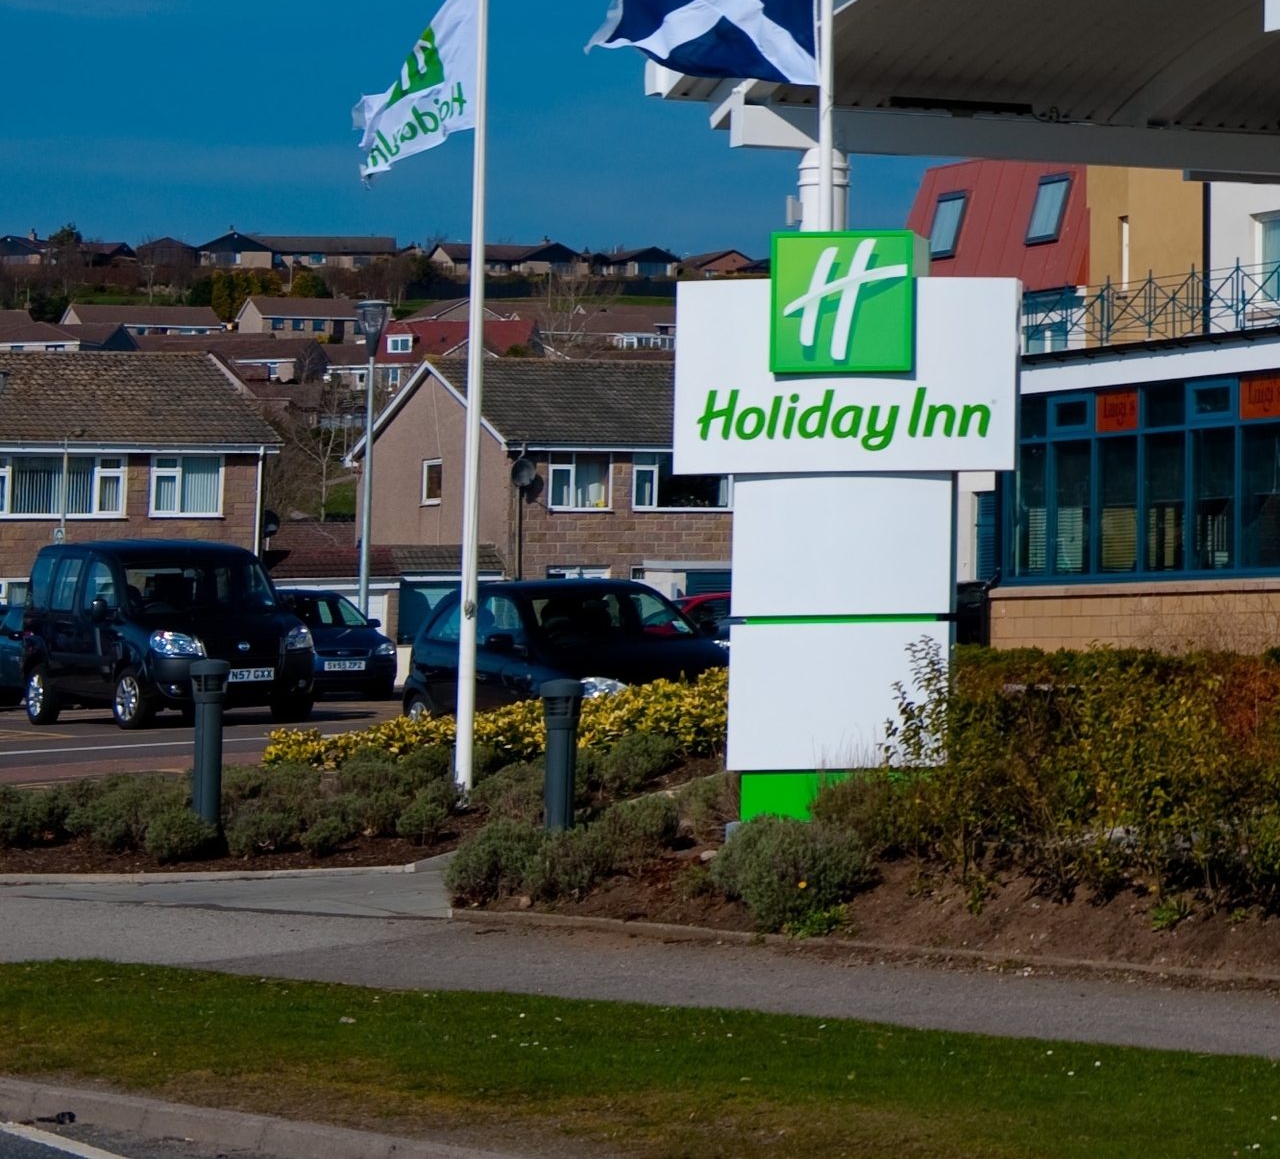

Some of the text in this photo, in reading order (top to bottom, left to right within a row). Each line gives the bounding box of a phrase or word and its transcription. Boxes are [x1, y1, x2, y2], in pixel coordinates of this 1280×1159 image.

[696, 385, 991, 453] Holiday Inn
[229, 668, 273, 681] N57 GXX
